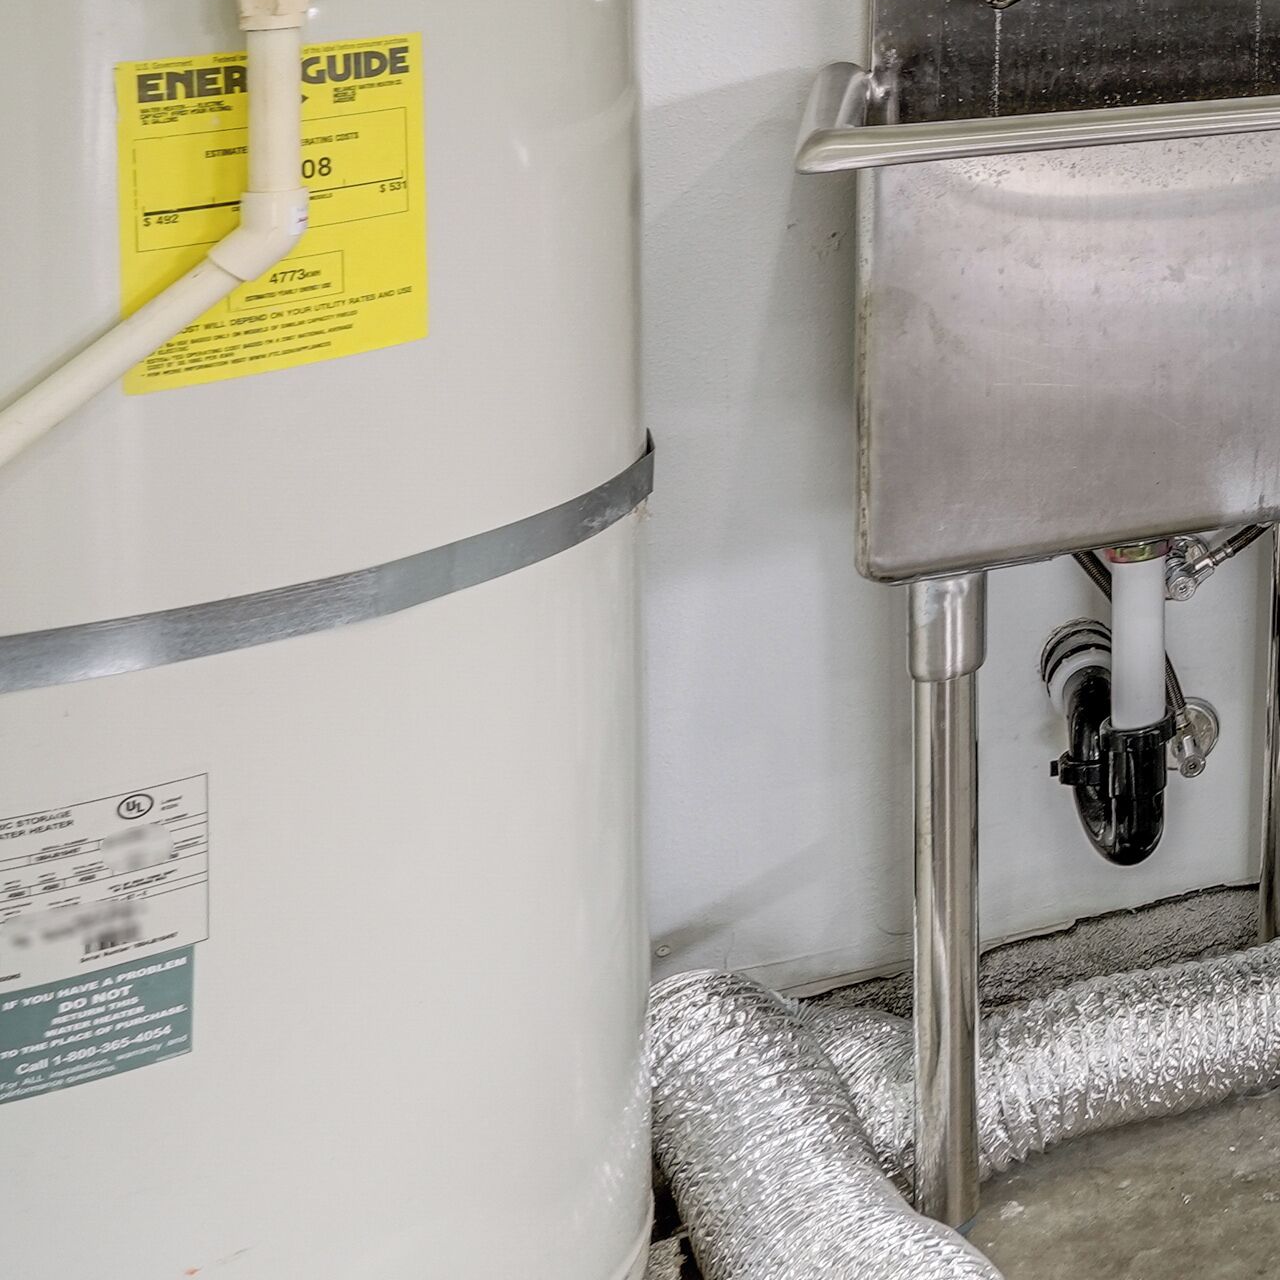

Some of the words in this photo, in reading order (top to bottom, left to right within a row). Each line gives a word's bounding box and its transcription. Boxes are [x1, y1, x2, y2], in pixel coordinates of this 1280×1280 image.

[137, 65, 248, 103] ENER
[205, 146, 248, 158] ESTIMATE
[301, 135, 334, 147] ERATING
[335, 131, 359, 141] COSTS
[302, 157, 332, 180] 08
[389, 180, 407, 192] 531
[156, 214, 179, 225] 492
[180, 324, 200, 334] OST
[204, 321, 226, 330] WILL
[230, 314, 267, 326] DEPEND
[287, 306, 311, 317] YOUR
[313, 300, 346, 312] UTILITY
[348, 293, 376, 305] RATES
[378, 289, 395, 299] AND
[397, 285, 413, 296] USE
[17, 810, 72, 827] STORAGE
[29, 820, 74, 834] HEATER
[2, 1000, 18, 1011] IF
[20, 992, 54, 1007] YOU
[55, 980, 99, 999] HAVE
[101, 977, 114, 988] A
[116, 957, 187, 983] PROBLEM
[58, 997, 87, 1014] DO
[91, 984, 134, 1005] NOT
[44, 1020, 91, 1038] WATER
[92, 1005, 145, 1025] HEATER
[51, 1006, 106, 1026] RETURN
[107, 996, 139, 1011] THIS
[15, 1057, 49, 1075] Call
[51, 1024, 172, 1066] 1-800-365-4054
[20, 1041, 49, 1055] THE
[49, 1031, 93, 1048] PLACE
[94, 1024, 113, 1036] OF
[21, 1074, 45, 1086] ALL
